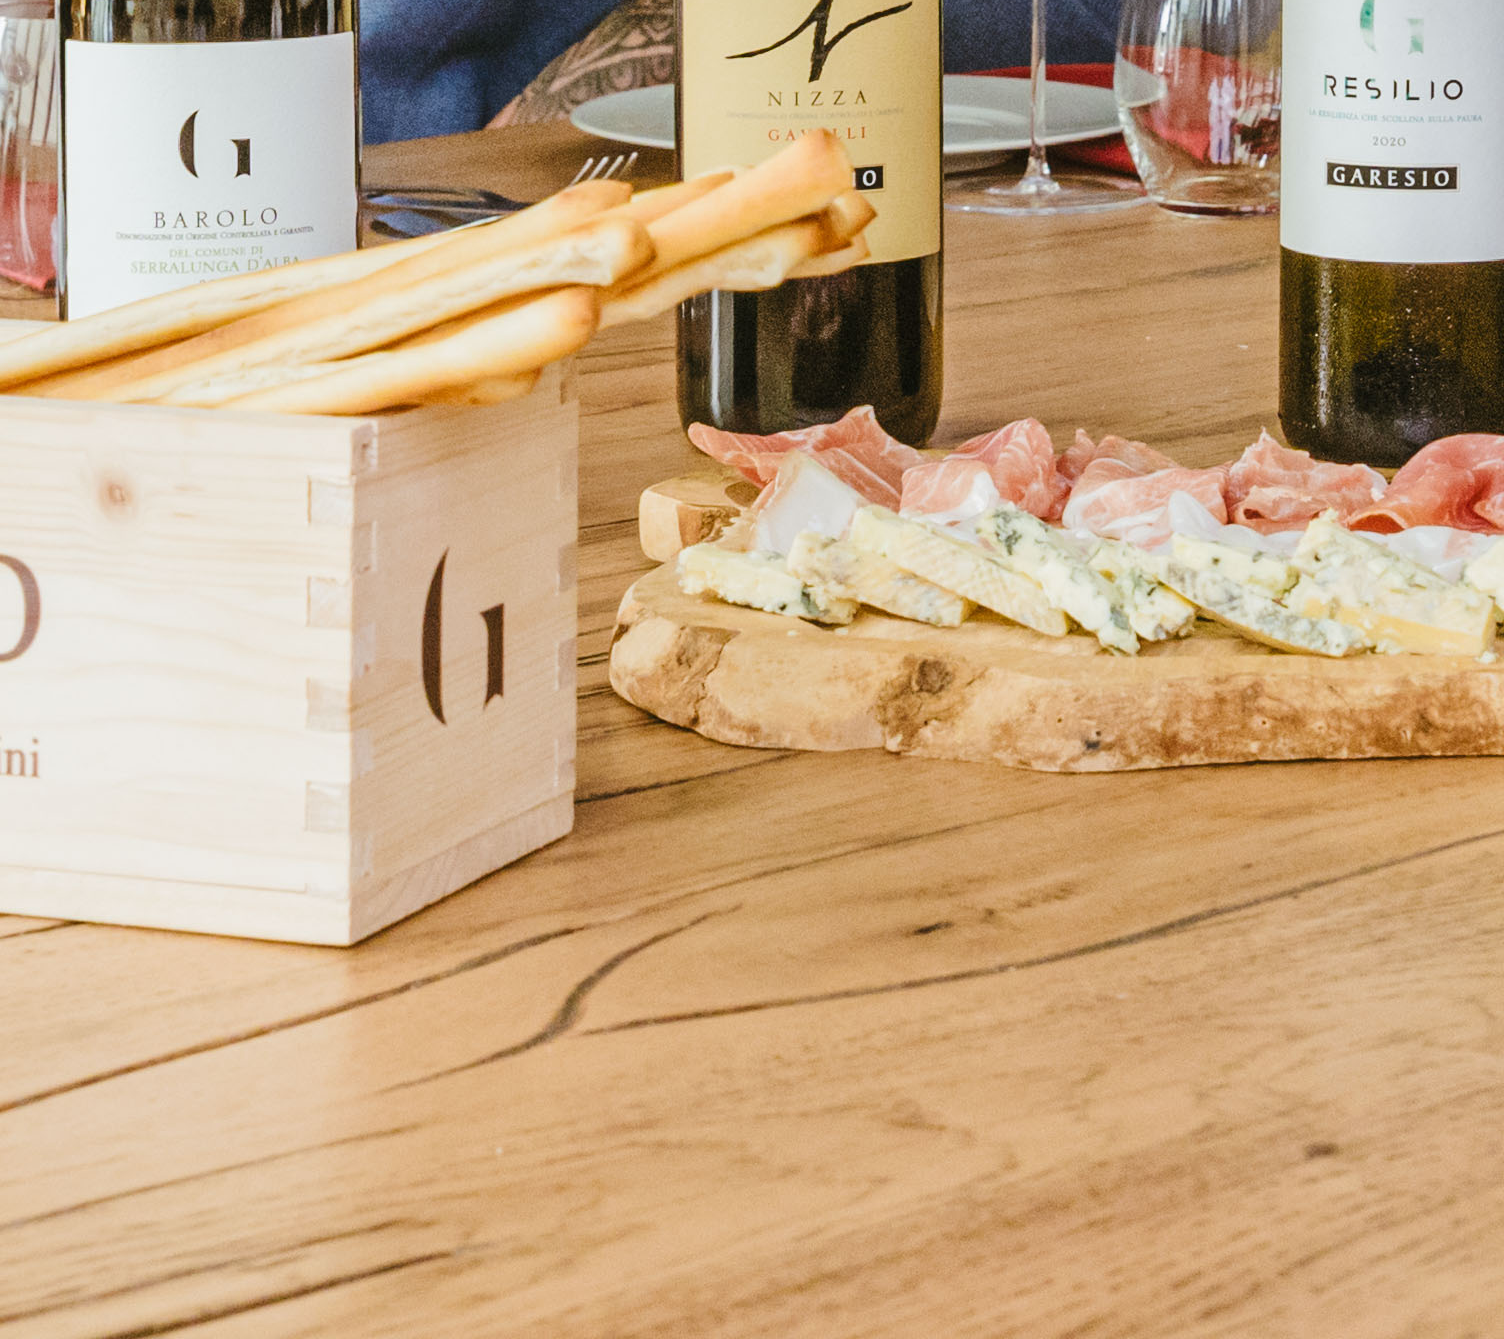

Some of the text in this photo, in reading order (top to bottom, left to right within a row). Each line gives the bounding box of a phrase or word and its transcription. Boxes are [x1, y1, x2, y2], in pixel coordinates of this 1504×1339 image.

[1323, 74, 1463, 101] RESILIO
[767, 90, 867, 107] NIZZA
[178, 108, 251, 179] G
[1372, 136, 1407, 147] 2020
[1332, 166, 1450, 187] GARESIO
[153, 207, 278, 229] BAROLO
[169, 246, 263, 257] DEL COMUNE DI
[130, 259, 240, 274] SERRALUNGA
